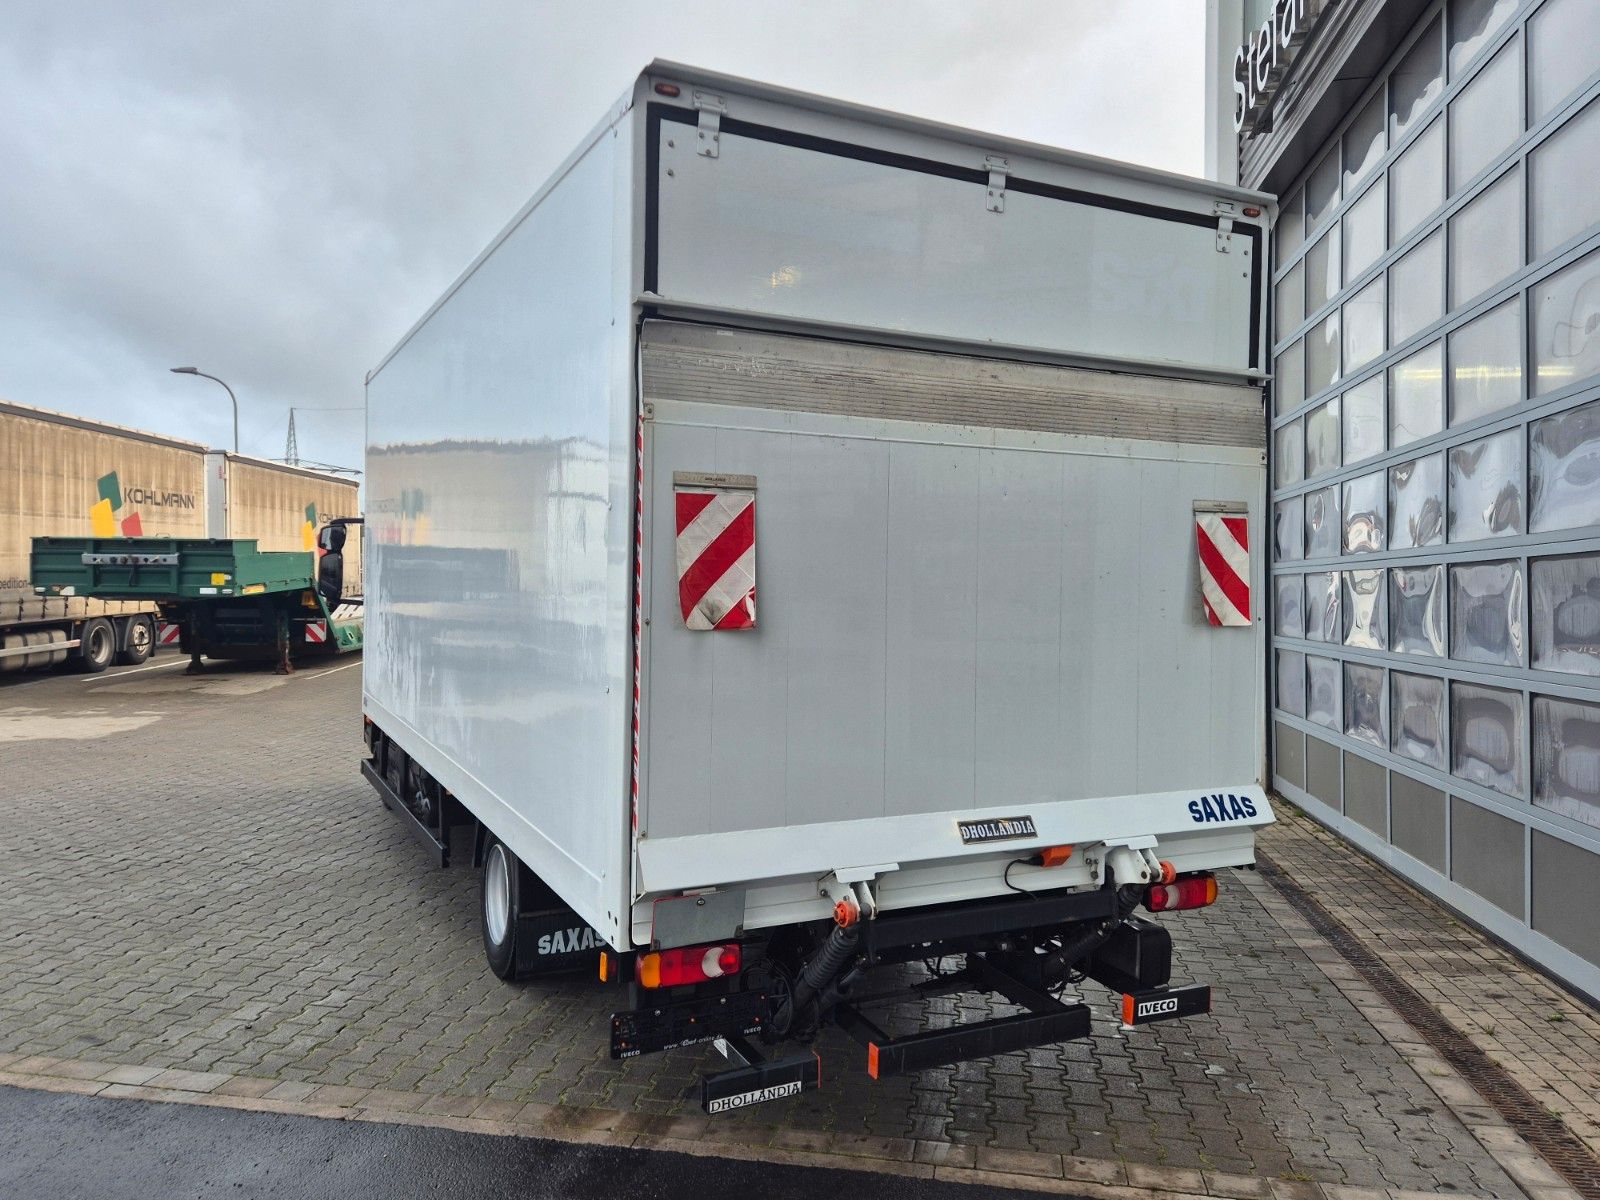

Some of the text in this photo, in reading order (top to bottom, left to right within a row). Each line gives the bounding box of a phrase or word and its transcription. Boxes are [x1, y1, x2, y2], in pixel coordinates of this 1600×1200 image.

[1233, 0, 1304, 134] Stera
[123, 487, 195, 509] KOHLMANN
[1188, 793, 1258, 823] SAXAS
[960, 820, 1035, 840] DHOLLANDIA
[1140, 1000, 1176, 1015] IVECO
[620, 1050, 641, 1059] IVECO
[710, 1082, 801, 1113] DHOLLANDIA
